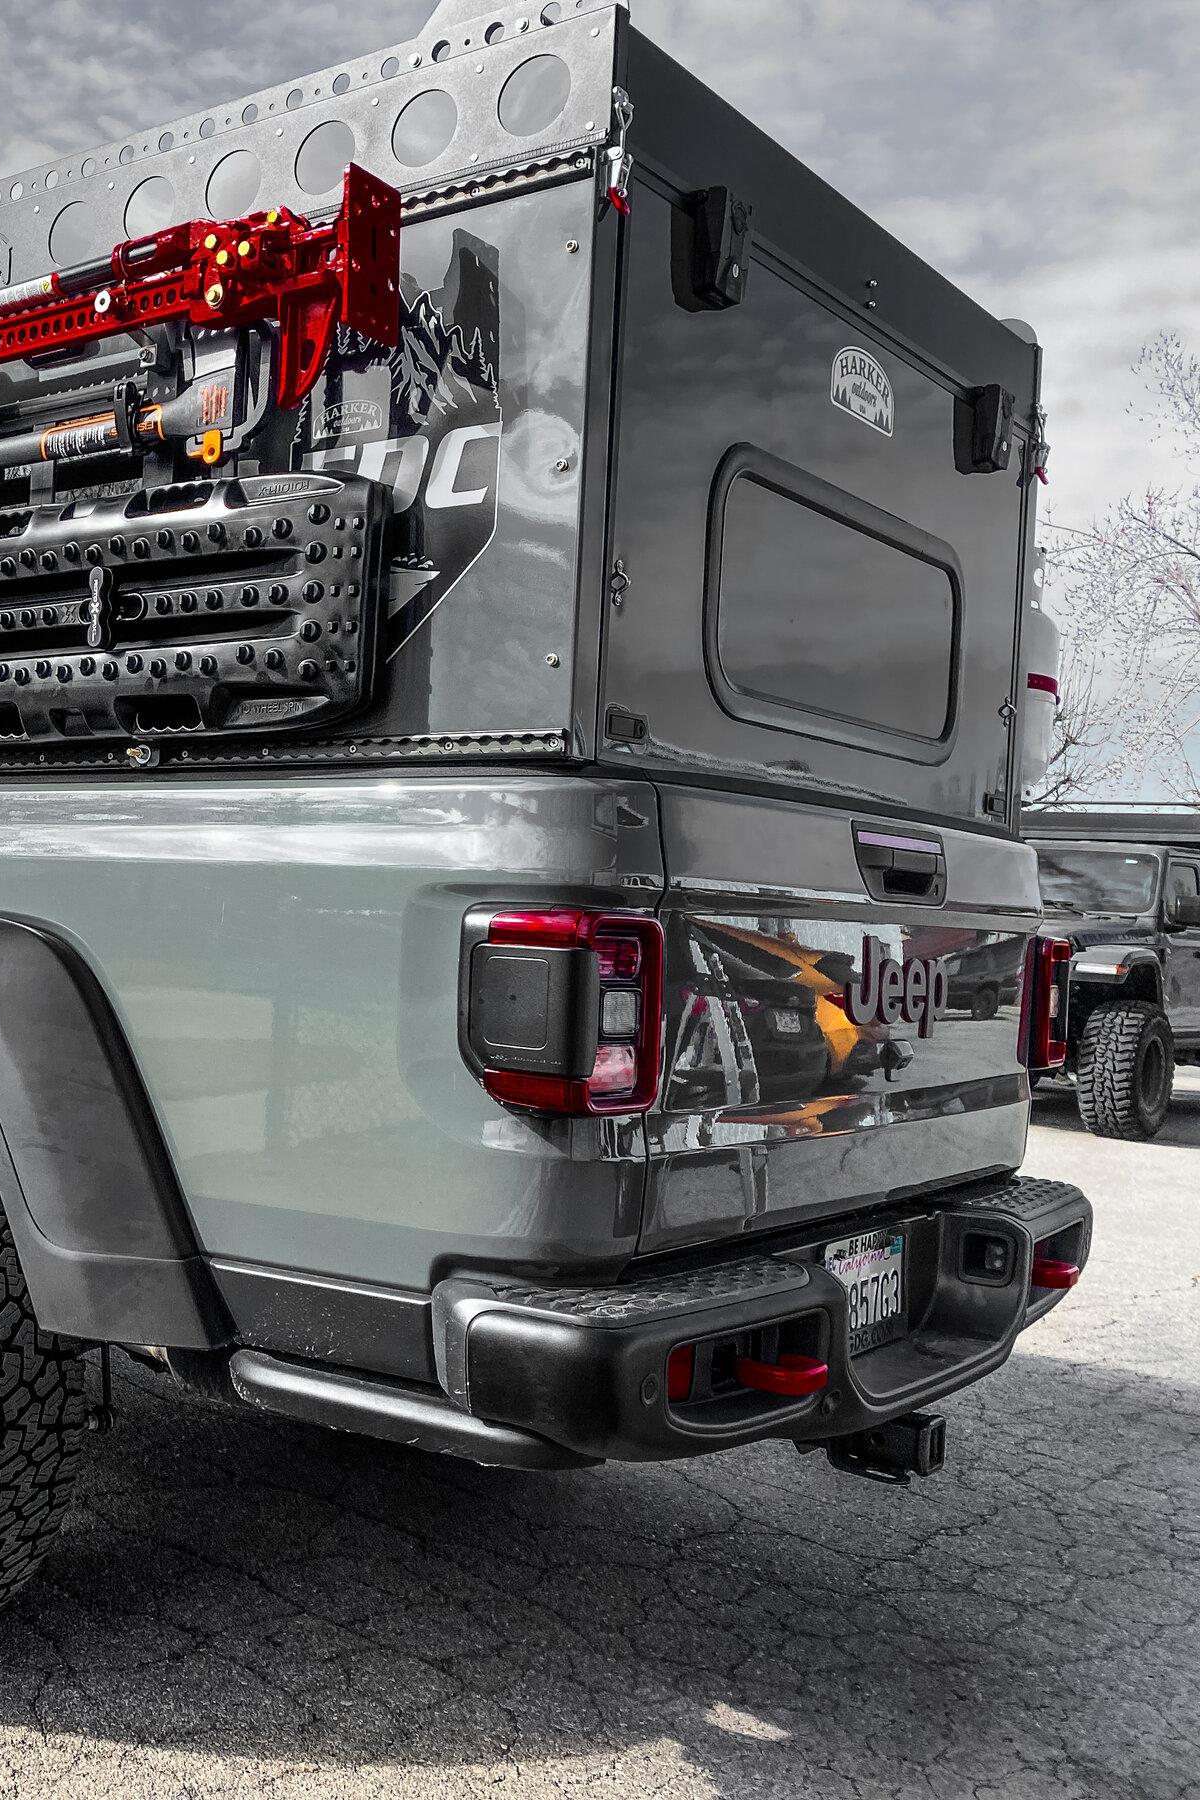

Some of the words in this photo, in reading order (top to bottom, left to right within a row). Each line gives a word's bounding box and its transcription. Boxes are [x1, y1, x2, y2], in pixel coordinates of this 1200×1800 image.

[840, 355, 889, 409] HARKER
[320, 402, 379, 426] HARKER
[301, 422, 503, 514] DC
[254, 702, 282, 714] WHEEL
[284, 701, 304, 713] SPIN
[843, 935, 948, 1039] Jeep
[848, 1239, 859, 1257] BE
